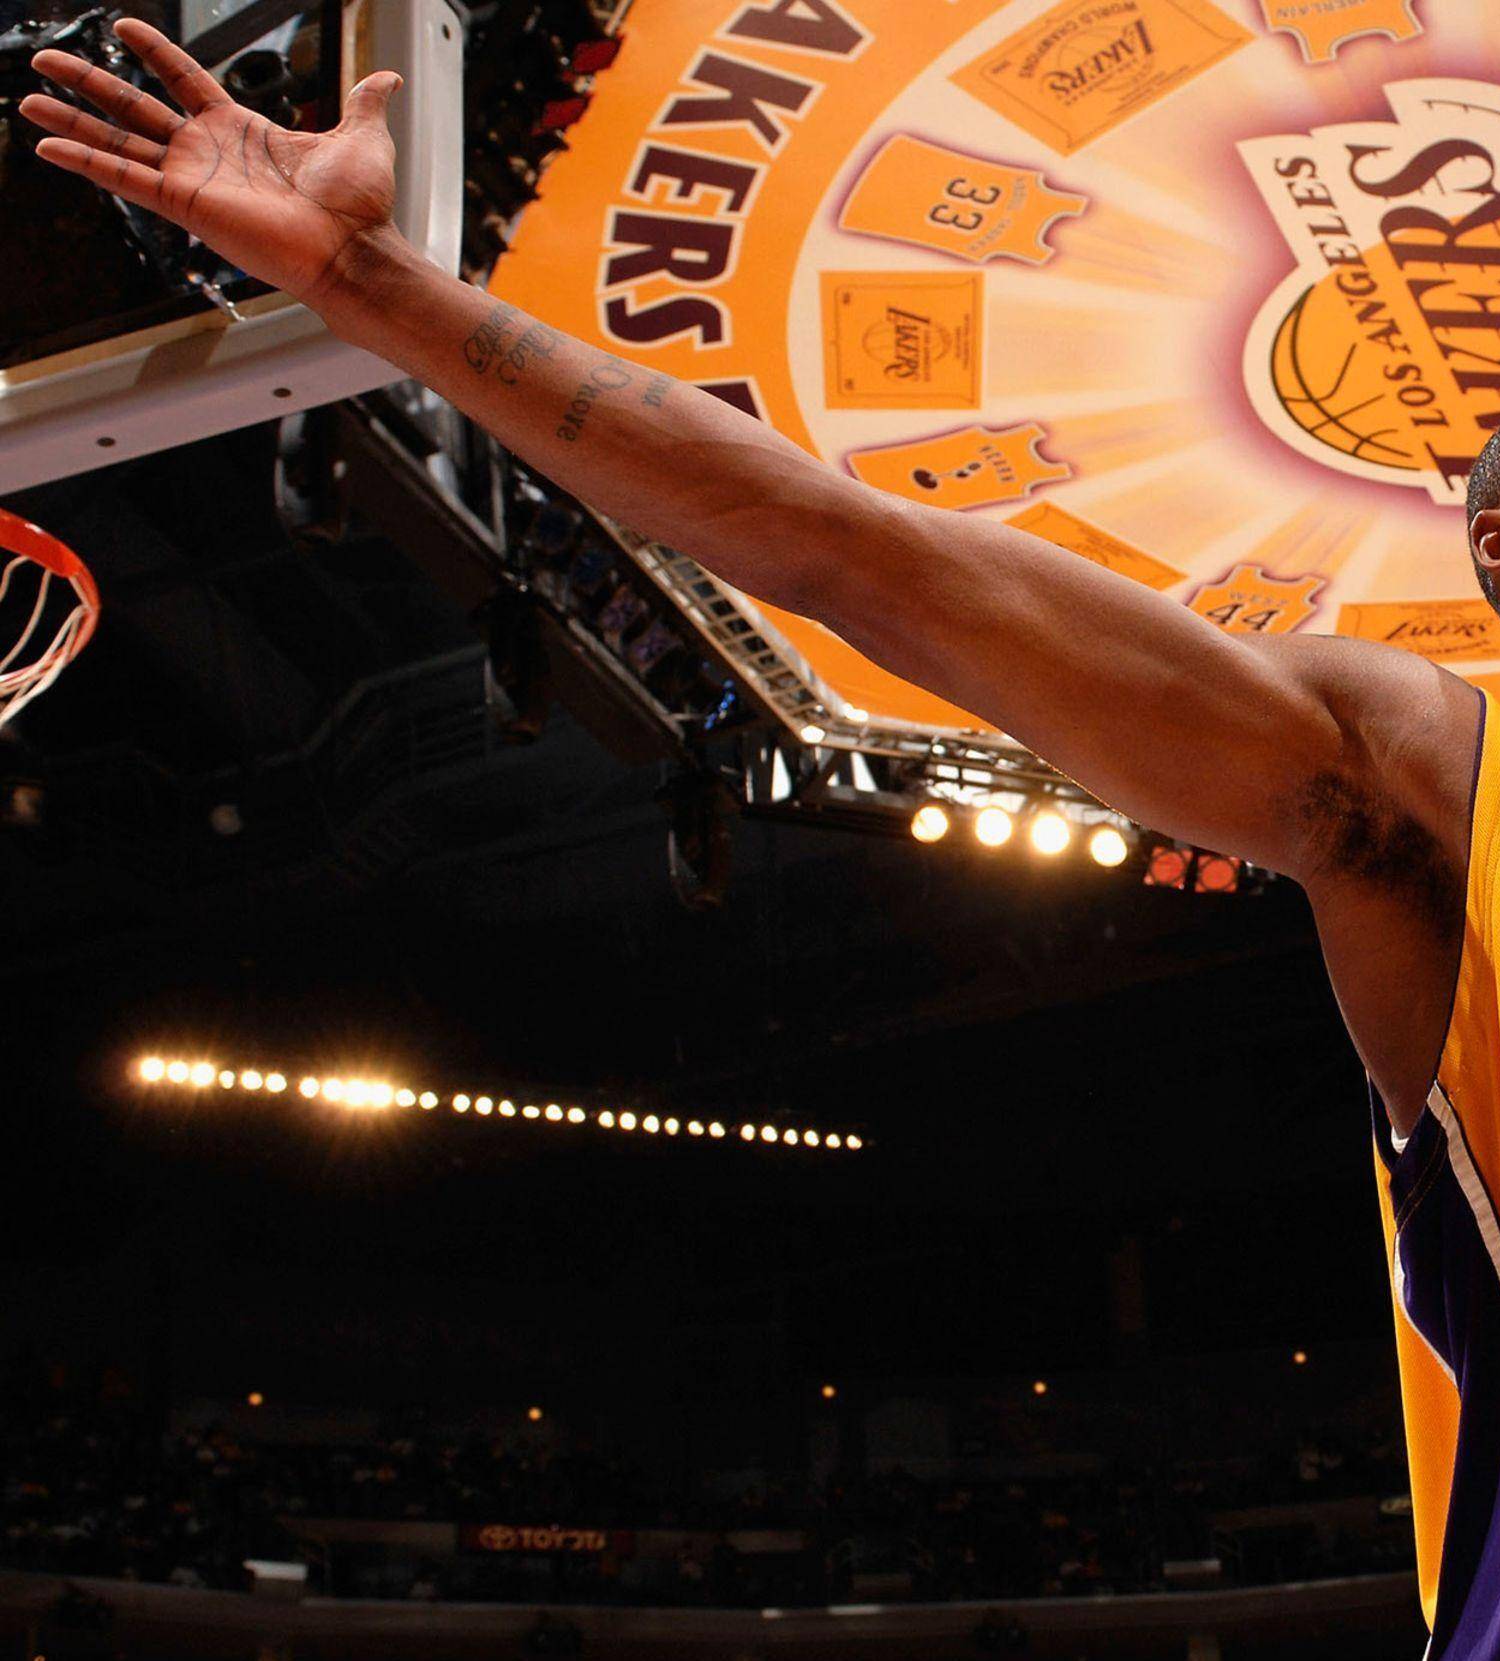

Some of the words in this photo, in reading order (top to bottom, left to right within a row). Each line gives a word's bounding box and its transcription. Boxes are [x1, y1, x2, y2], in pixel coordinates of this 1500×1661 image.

[1040, 18, 1155, 97] LAKERS
[594, 0, 876, 352] AKERS
[927, 176, 1002, 232] 33
[1273, 156, 1413, 356] ANGELES
[882, 305, 932, 382] LAKERS
[1383, 363, 1450, 429] LOS
[1204, 602, 1281, 632] 44
